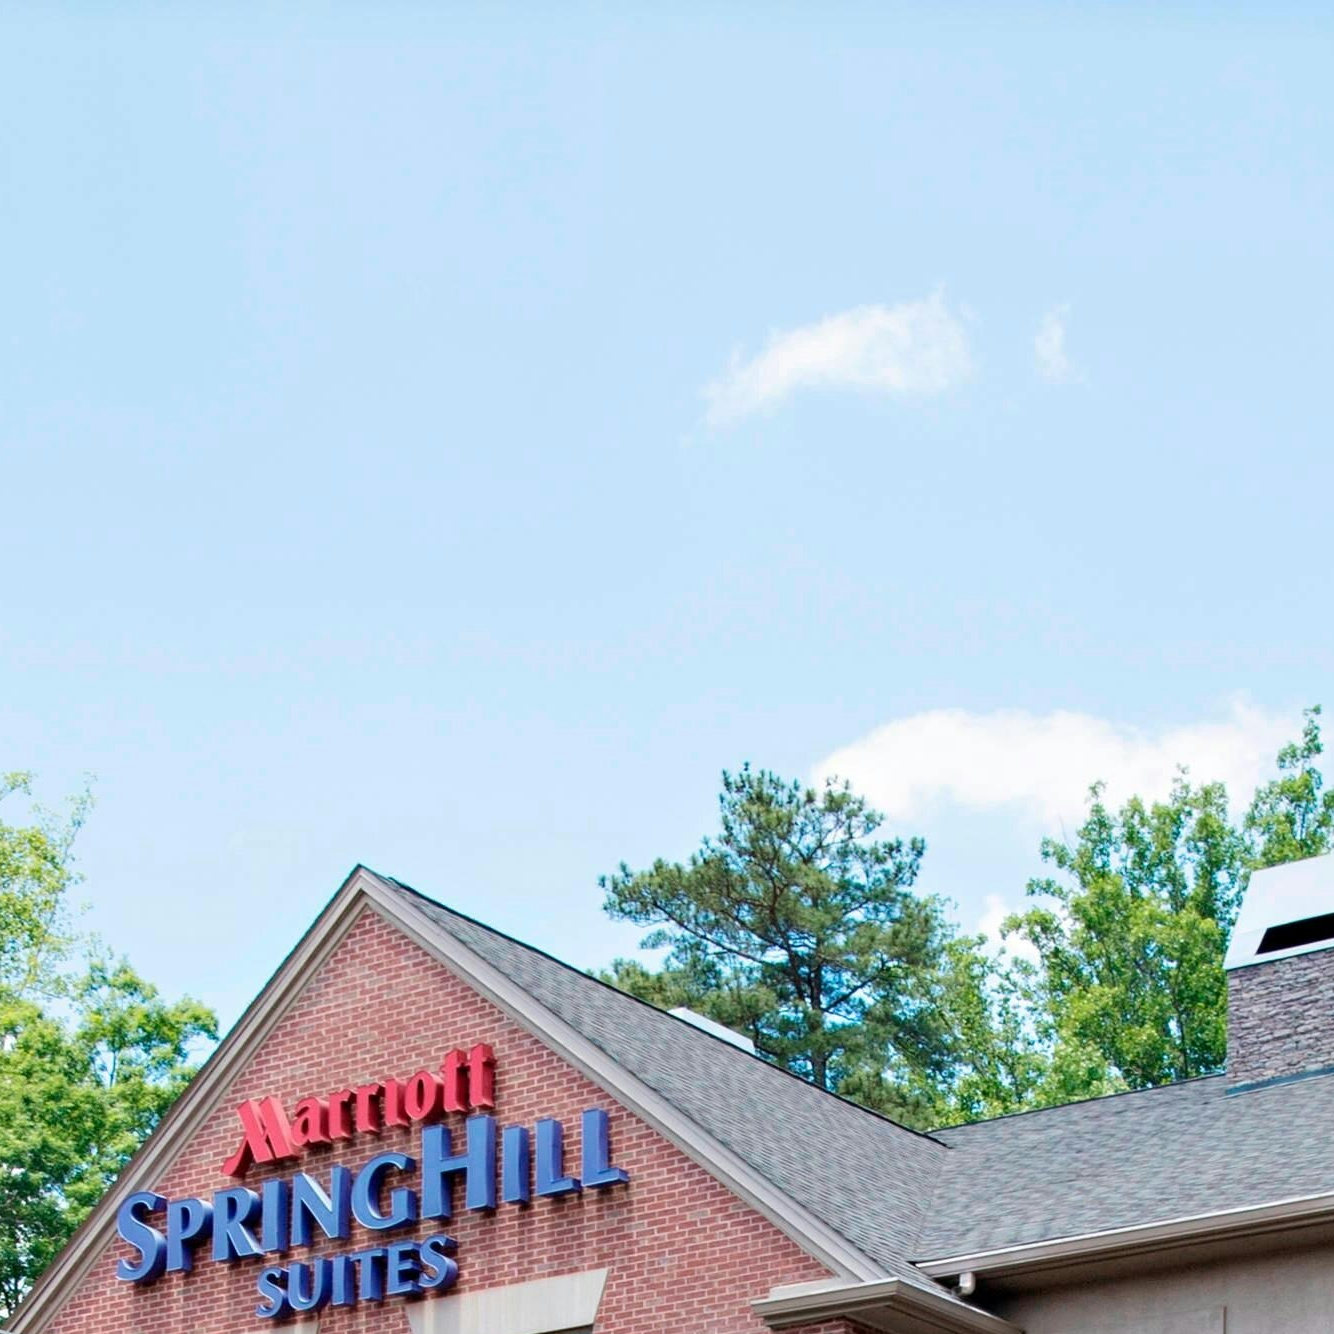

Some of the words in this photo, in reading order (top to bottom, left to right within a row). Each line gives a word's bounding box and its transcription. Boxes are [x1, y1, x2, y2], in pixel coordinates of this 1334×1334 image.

[221, 1043, 497, 1177] Marriott
[116, 1108, 629, 1283] SPRINGHILL
[256, 1235, 458, 1319] SUITES
